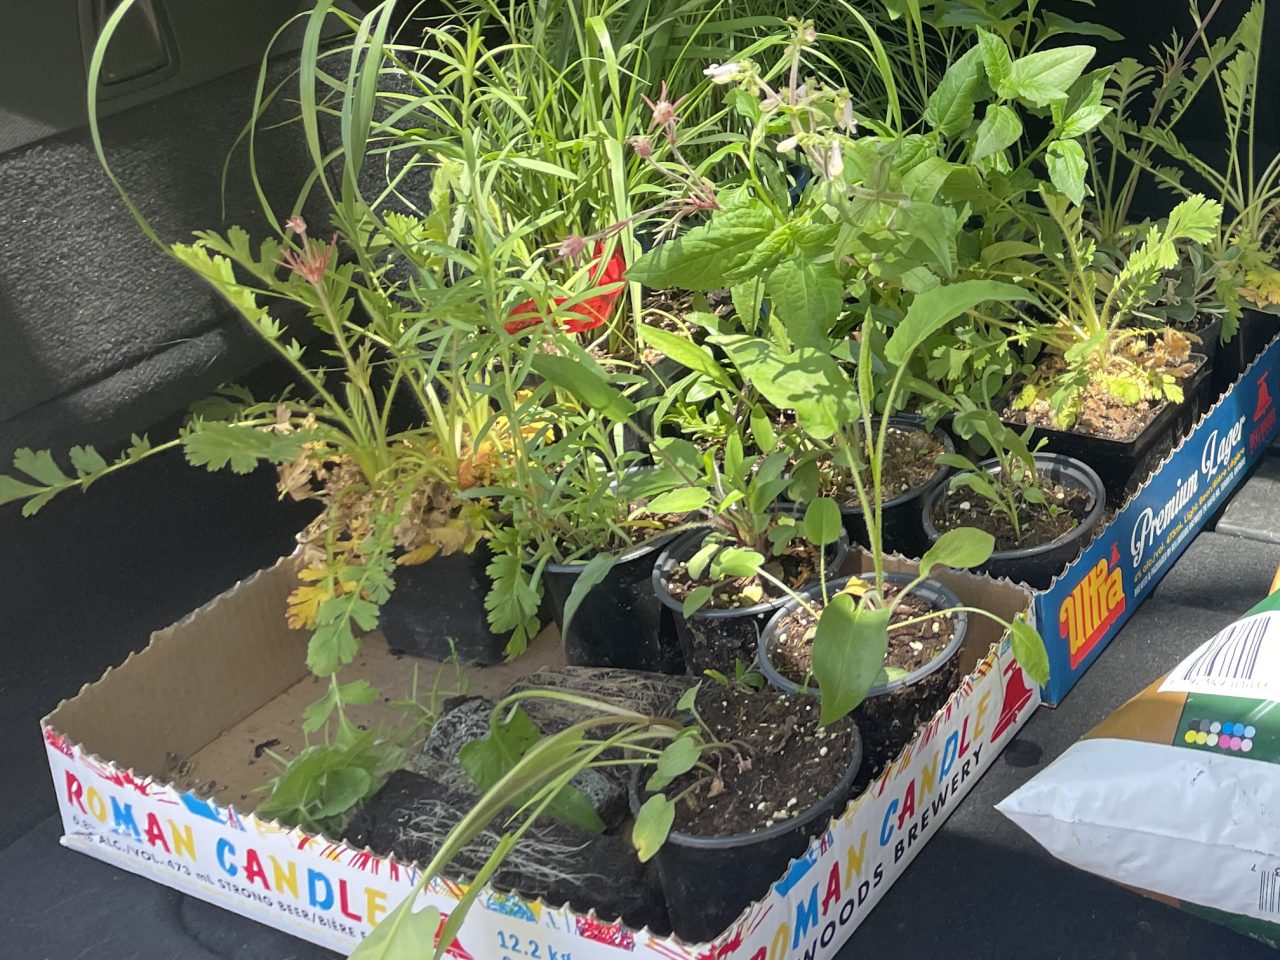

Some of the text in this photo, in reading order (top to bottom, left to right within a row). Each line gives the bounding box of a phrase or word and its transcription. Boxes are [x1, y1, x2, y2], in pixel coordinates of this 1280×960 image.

[1131, 469, 1198, 568] Premium
[1202, 415, 1246, 483] Lager
[1060, 558, 1124, 658] Ultra
[880, 690, 991, 847] CANDLE
[895, 742, 983, 864] BREWERY
[65, 770, 388, 930] ROMAN CANDLE
[167, 860, 191, 876] 473
[217, 879, 273, 907] STRONG
[277, 901, 356, 938] BEER/BIÈRE
[1250, 863, 1257, 872] 7
[497, 930, 541, 959] 12.2
